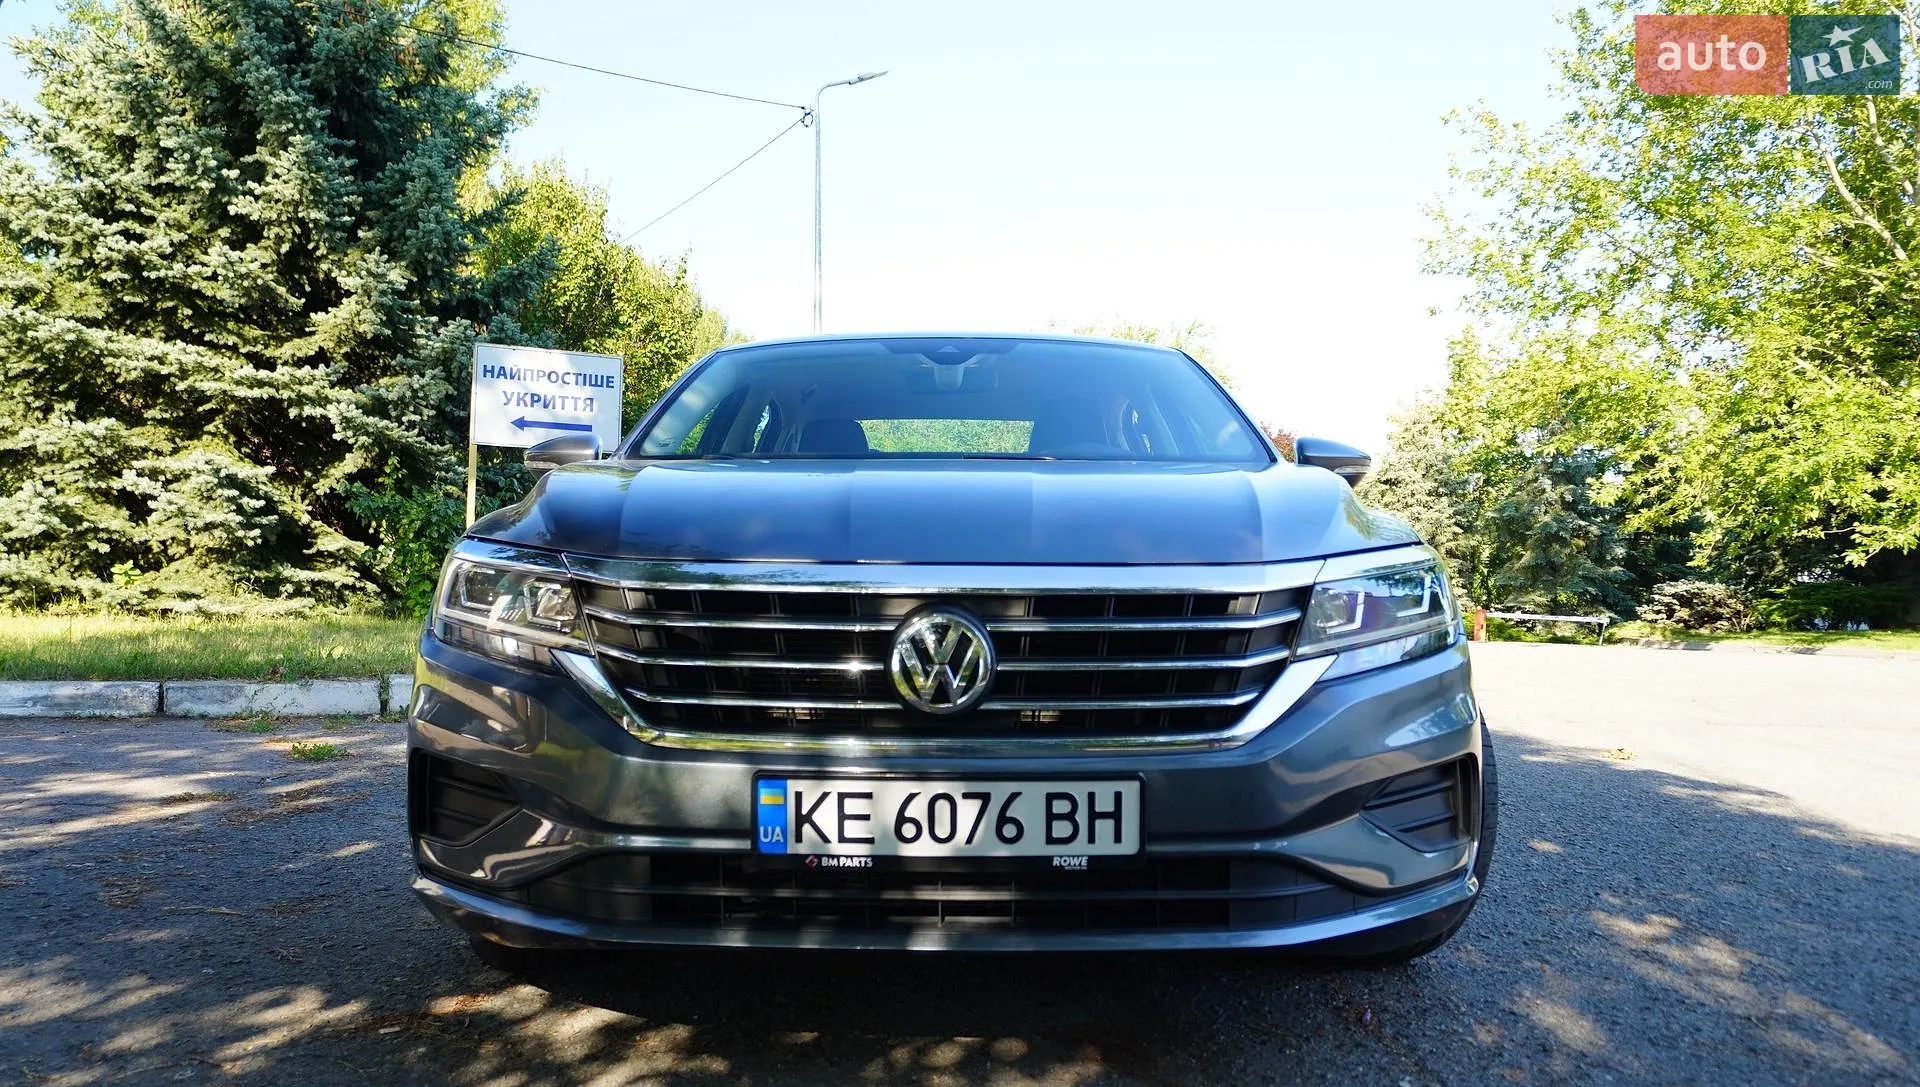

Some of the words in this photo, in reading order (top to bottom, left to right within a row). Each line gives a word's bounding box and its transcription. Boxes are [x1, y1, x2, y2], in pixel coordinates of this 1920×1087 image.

[482, 363, 615, 389] НАЙПРОСТІШЕ
[502, 390, 594, 413] УКРИТТЯ
[794, 791, 875, 845] KE
[893, 791, 1025, 845] 6076
[1045, 791, 1123, 845] BH
[759, 826, 784, 843] UA
[821, 856, 839, 867] BM
[839, 856, 873, 867] PARTS
[1052, 856, 1088, 867] ROWE
